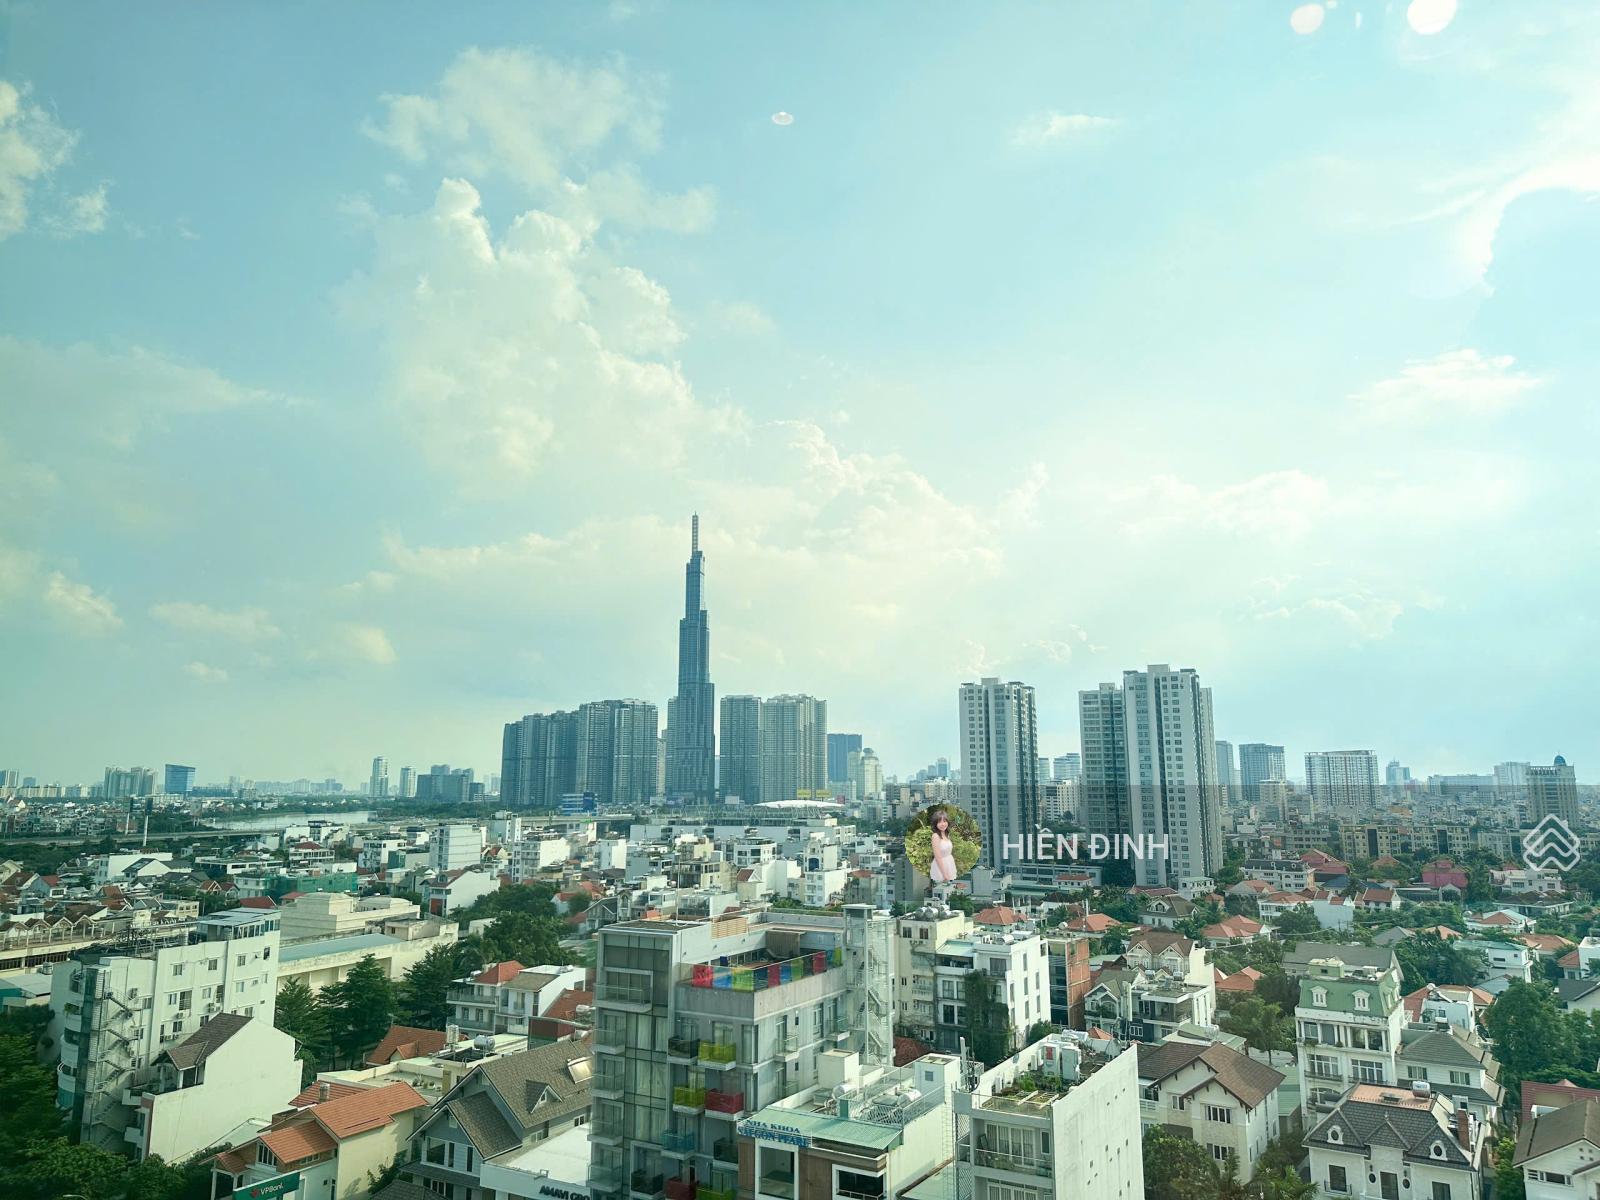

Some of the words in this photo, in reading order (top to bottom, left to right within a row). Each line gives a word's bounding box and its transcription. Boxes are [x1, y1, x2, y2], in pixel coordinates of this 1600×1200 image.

[746, 1119, 768, 1128] NHA
[770, 1123, 800, 1133] KHOA
[260, 1182, 284, 1195] VPBank
